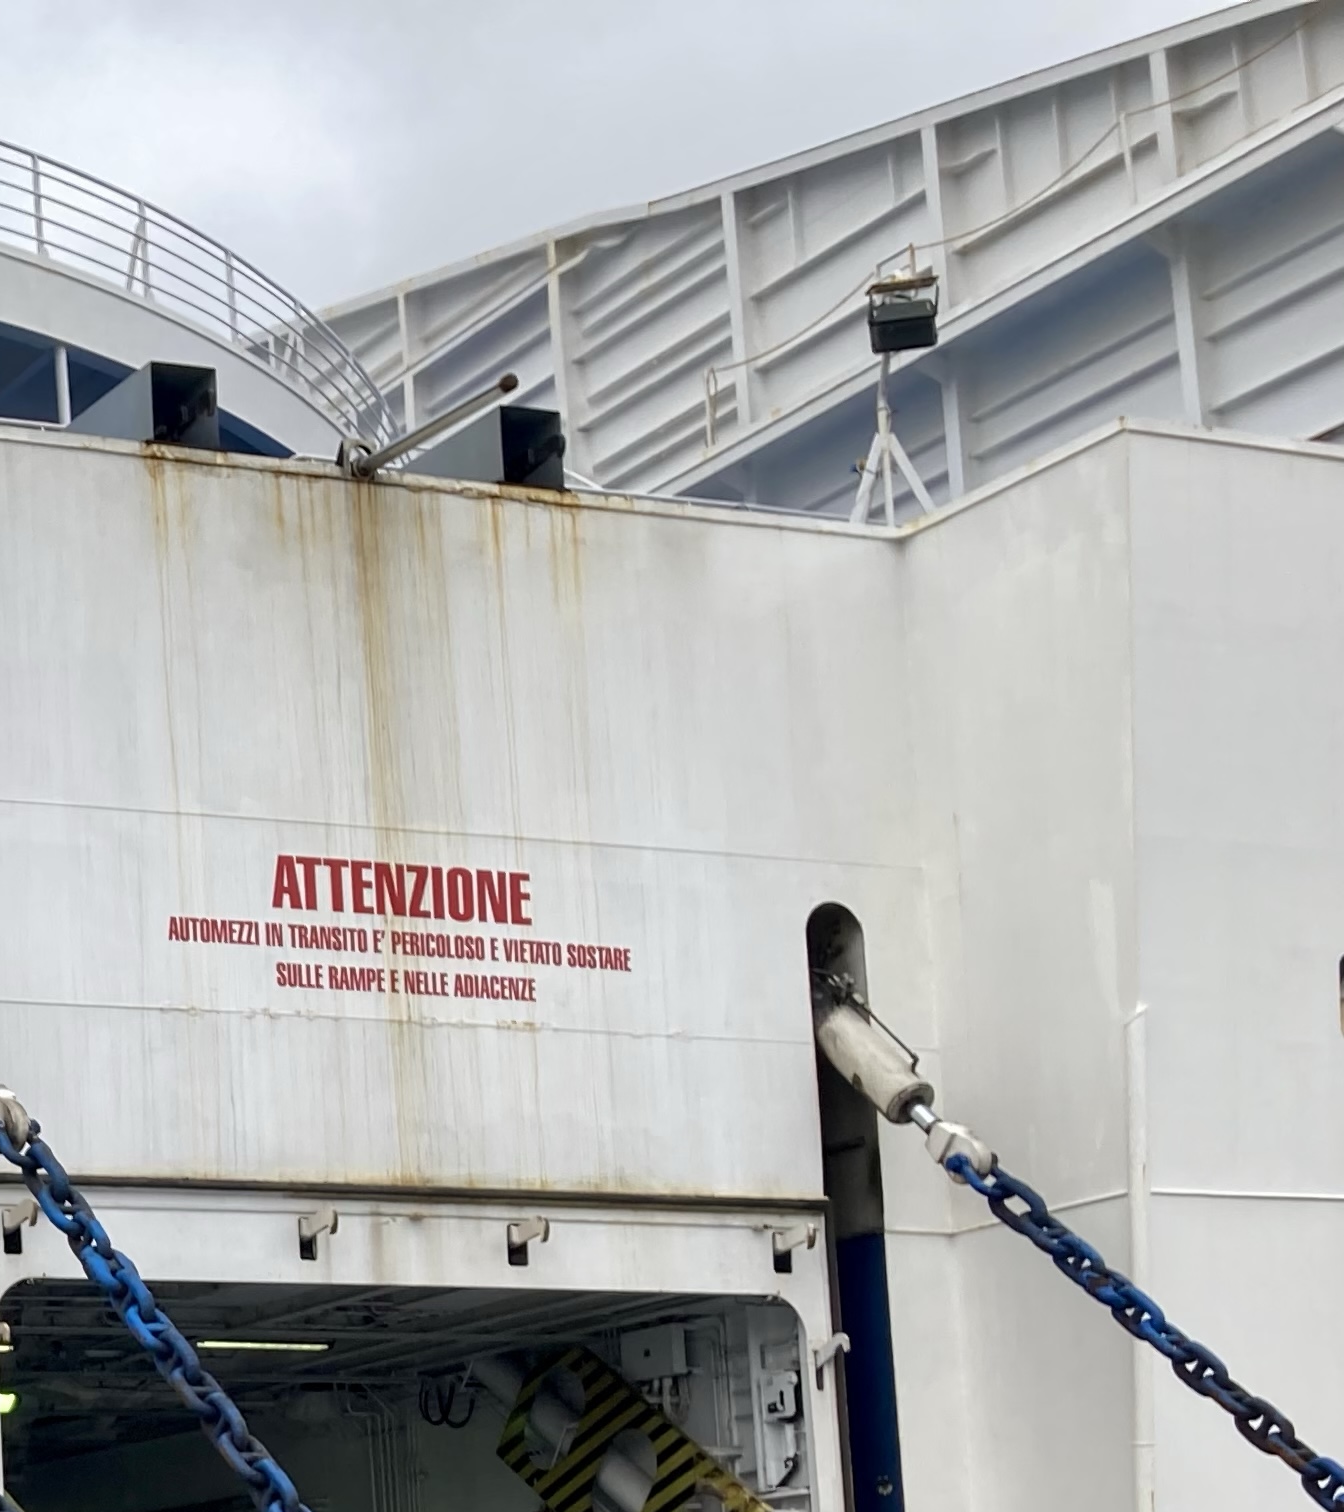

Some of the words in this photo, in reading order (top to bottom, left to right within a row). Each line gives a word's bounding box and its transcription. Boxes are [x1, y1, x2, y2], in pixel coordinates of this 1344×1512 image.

[271, 854, 532, 926] ATTENZIONE
[168, 916, 260, 945] AUTOMEZZI
[265, 923, 283, 947] IN
[288, 924, 368, 953] TRANSITO
[391, 931, 485, 961] PERICOLOSO
[489, 938, 499, 961] E
[503, 939, 562, 966] VIETATO
[566, 943, 632, 972] SOSTARE
[276, 961, 323, 988] SULLE
[328, 966, 385, 992] RAMPE
[389, 969, 399, 994] E
[403, 970, 449, 996] NELLE
[454, 974, 537, 1002] ADIACENZE
